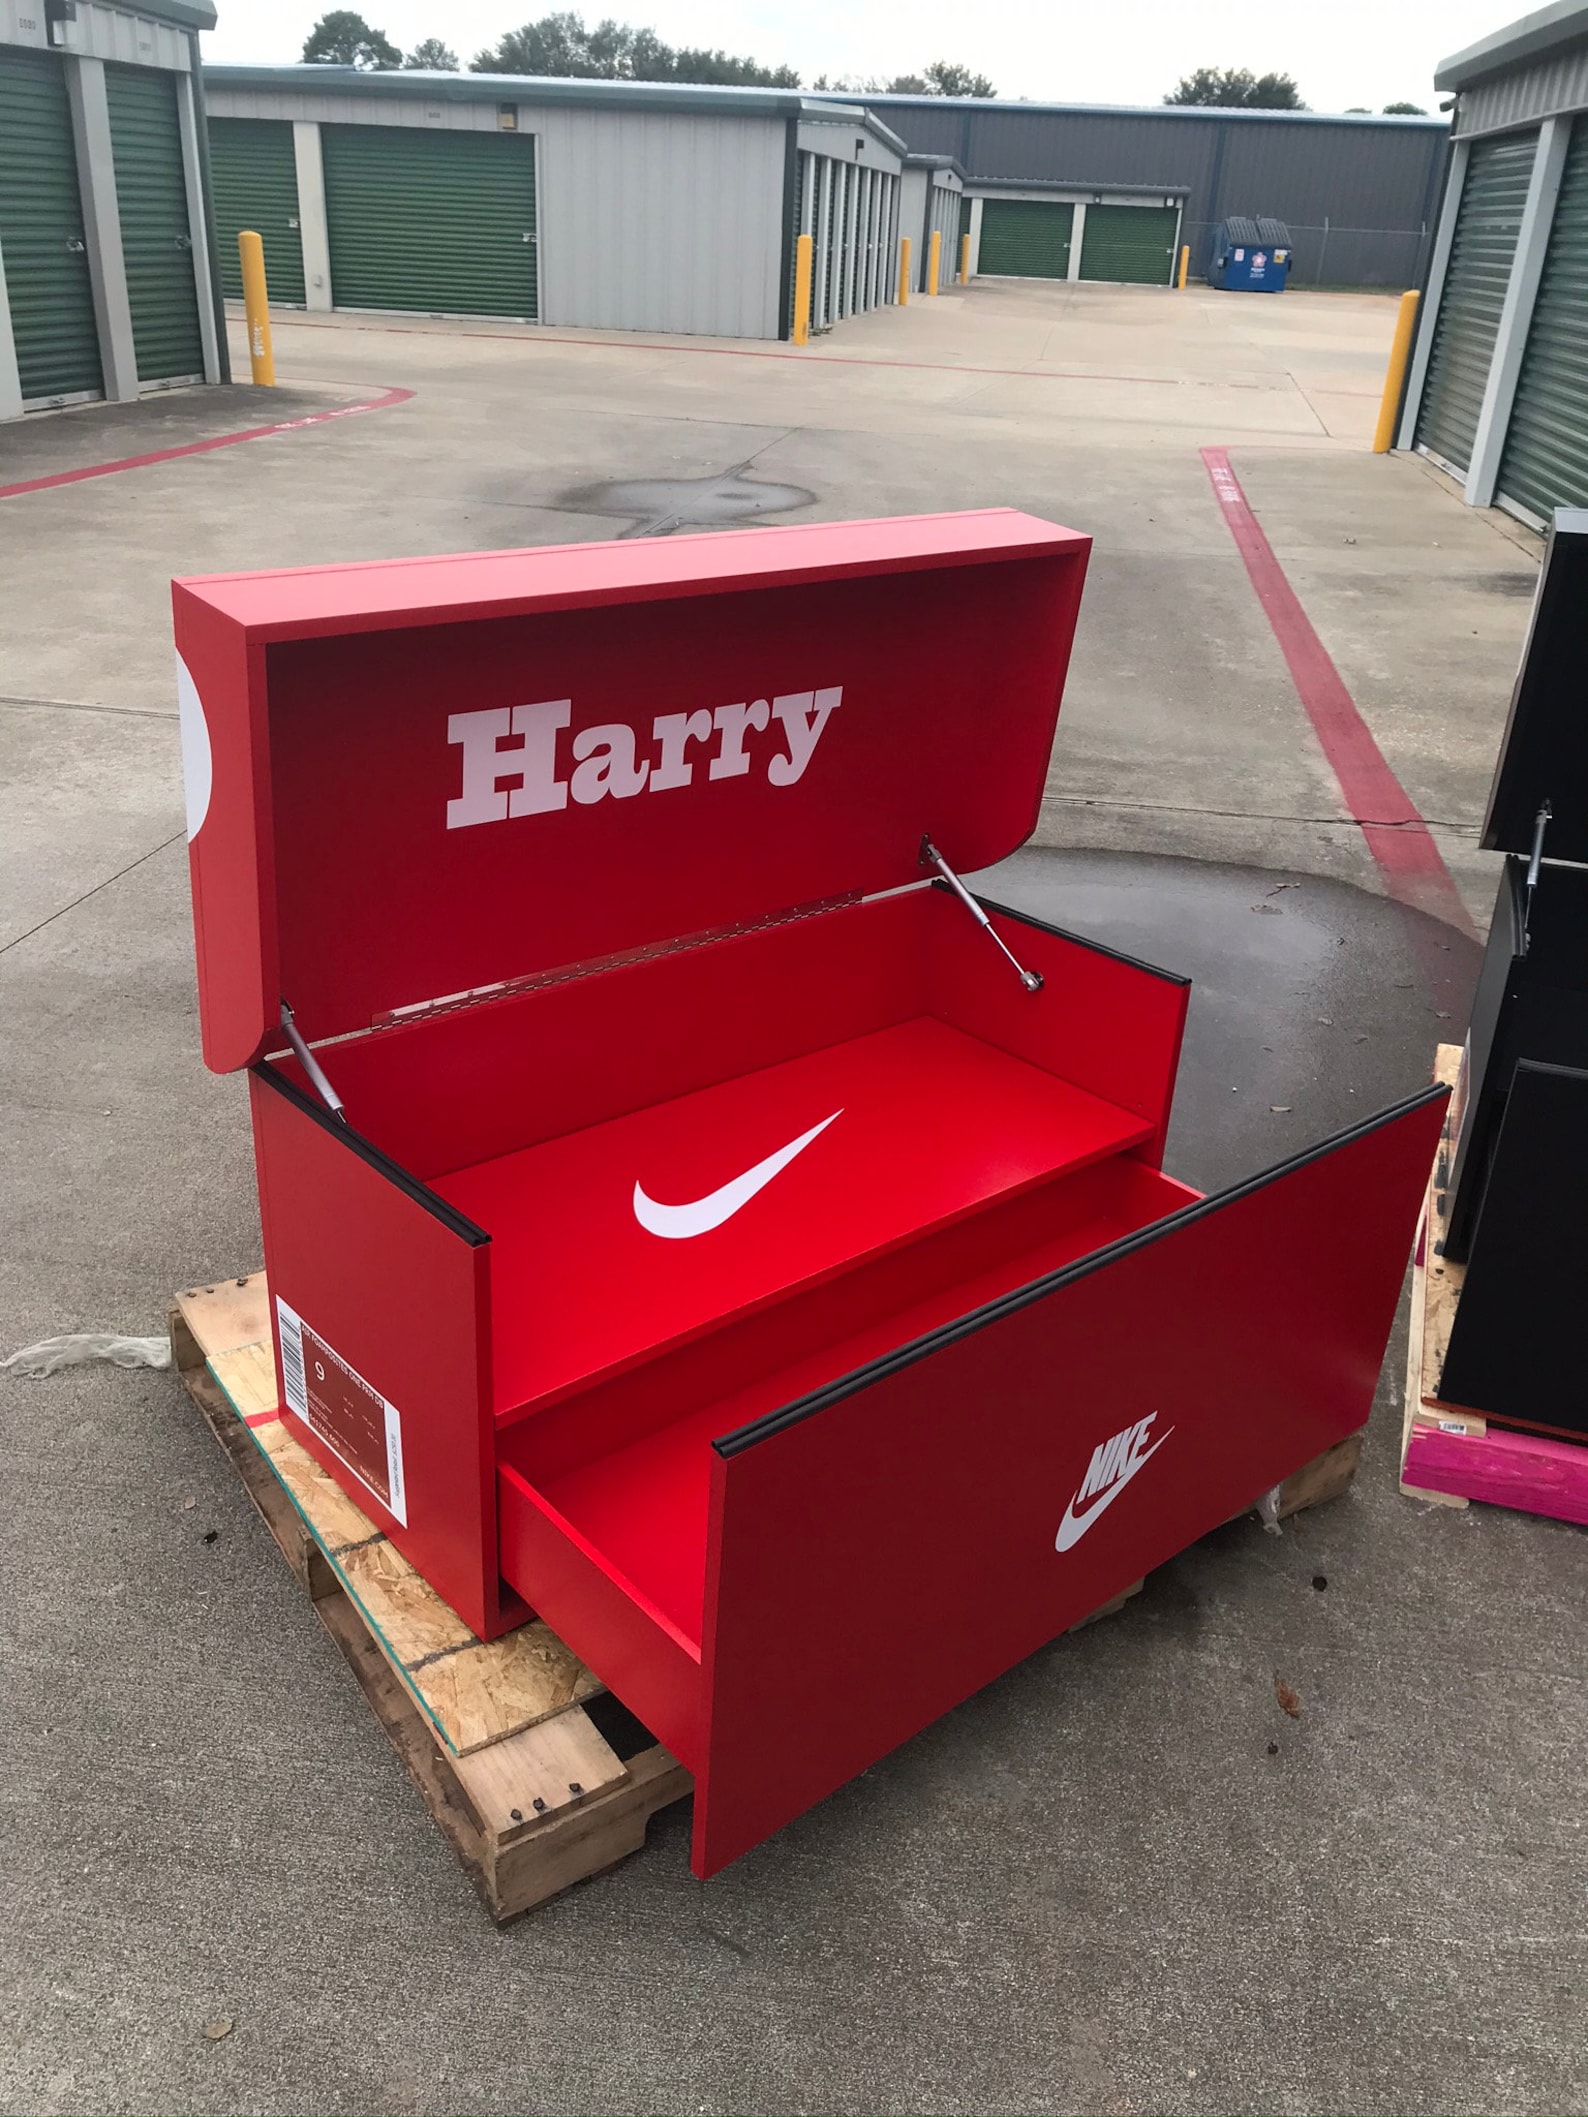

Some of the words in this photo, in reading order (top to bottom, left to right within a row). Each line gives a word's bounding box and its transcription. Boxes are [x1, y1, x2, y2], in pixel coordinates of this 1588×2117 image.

[446, 685, 843, 830] Harry
[314, 1360, 325, 1382] 9
[359, 1464, 388, 1498] NIKE.COM
[1076, 1410, 1158, 1504] NIKE
